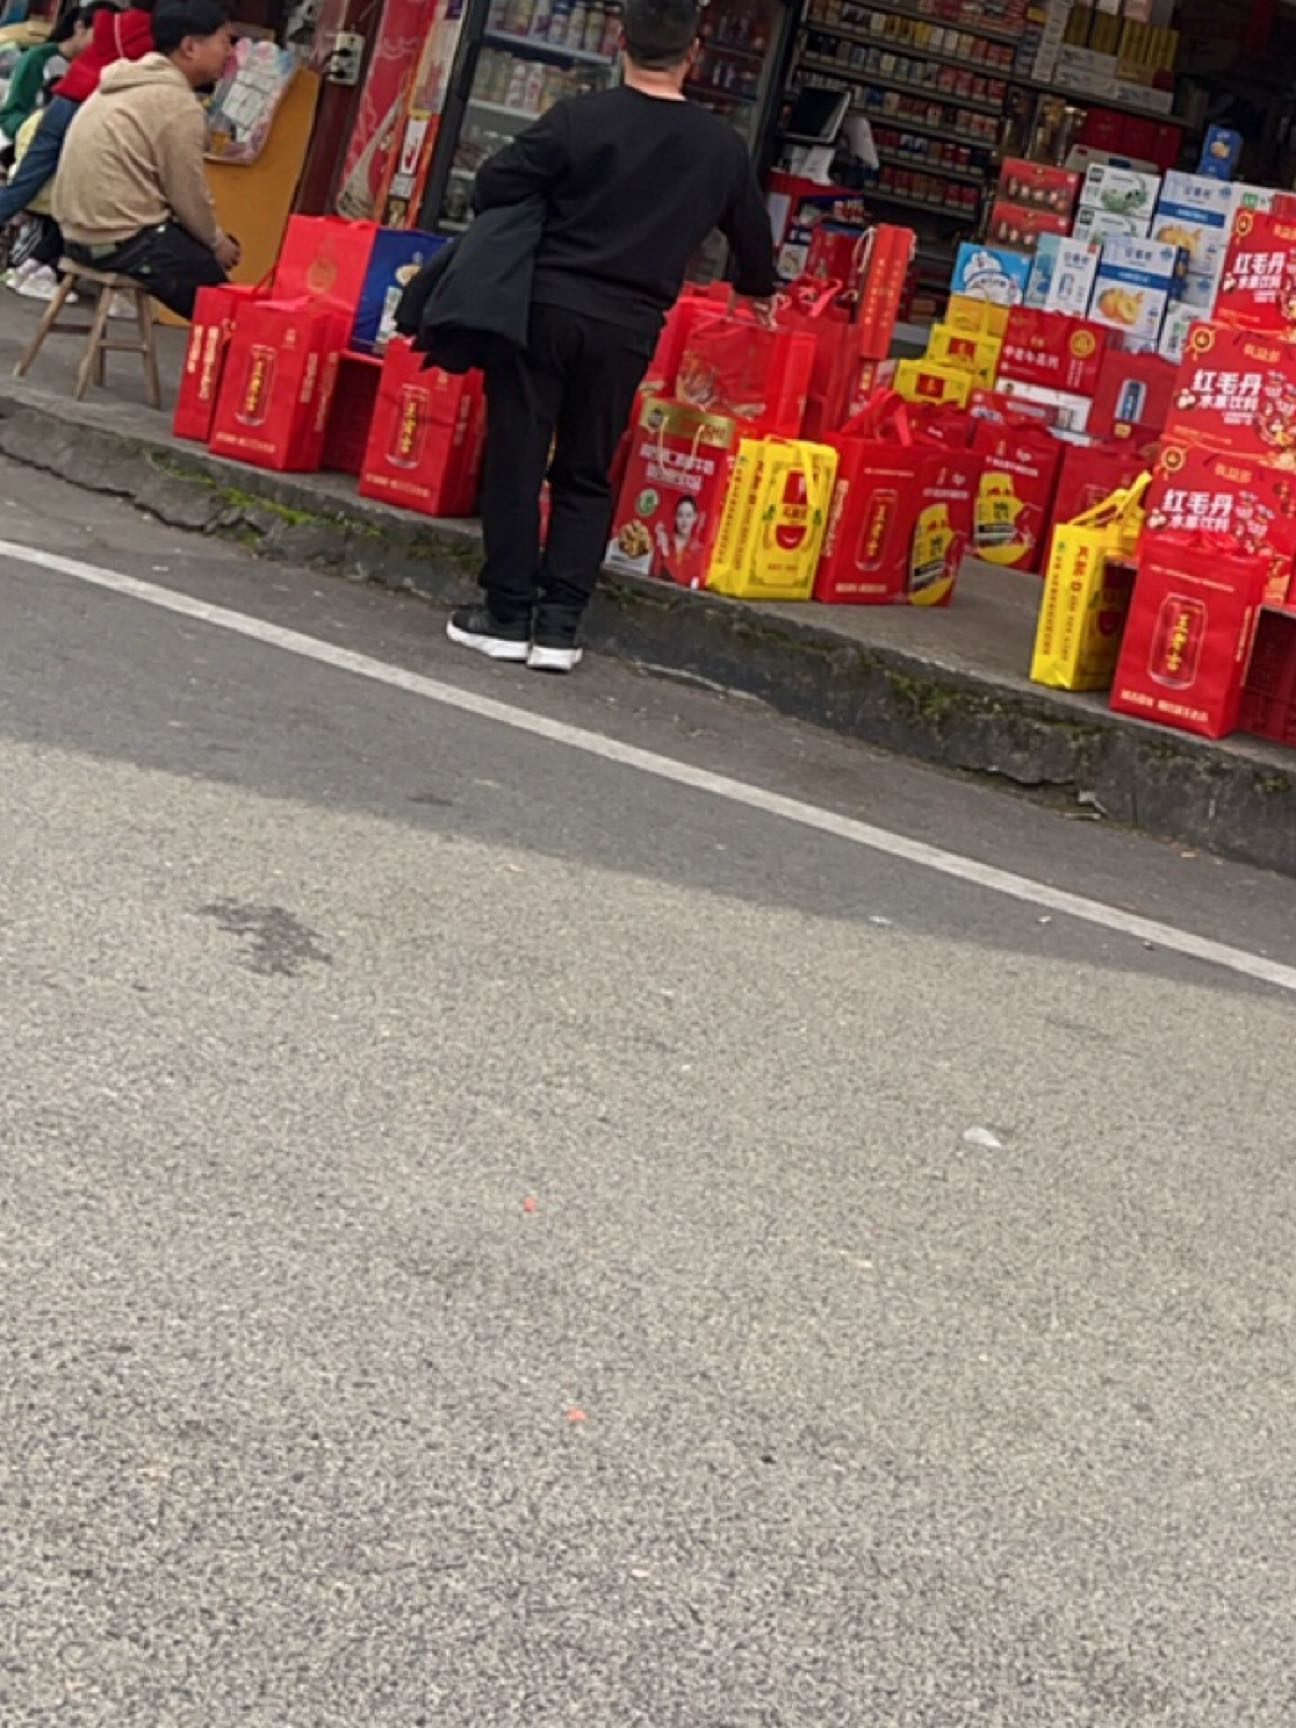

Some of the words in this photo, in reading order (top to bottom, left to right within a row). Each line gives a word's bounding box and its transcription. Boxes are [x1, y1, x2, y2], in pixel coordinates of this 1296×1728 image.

[1233, 251, 1287, 275] 红毛丹
[1192, 368, 1263, 397] 红毛丹
[1161, 488, 1233, 517] 红毛丹
